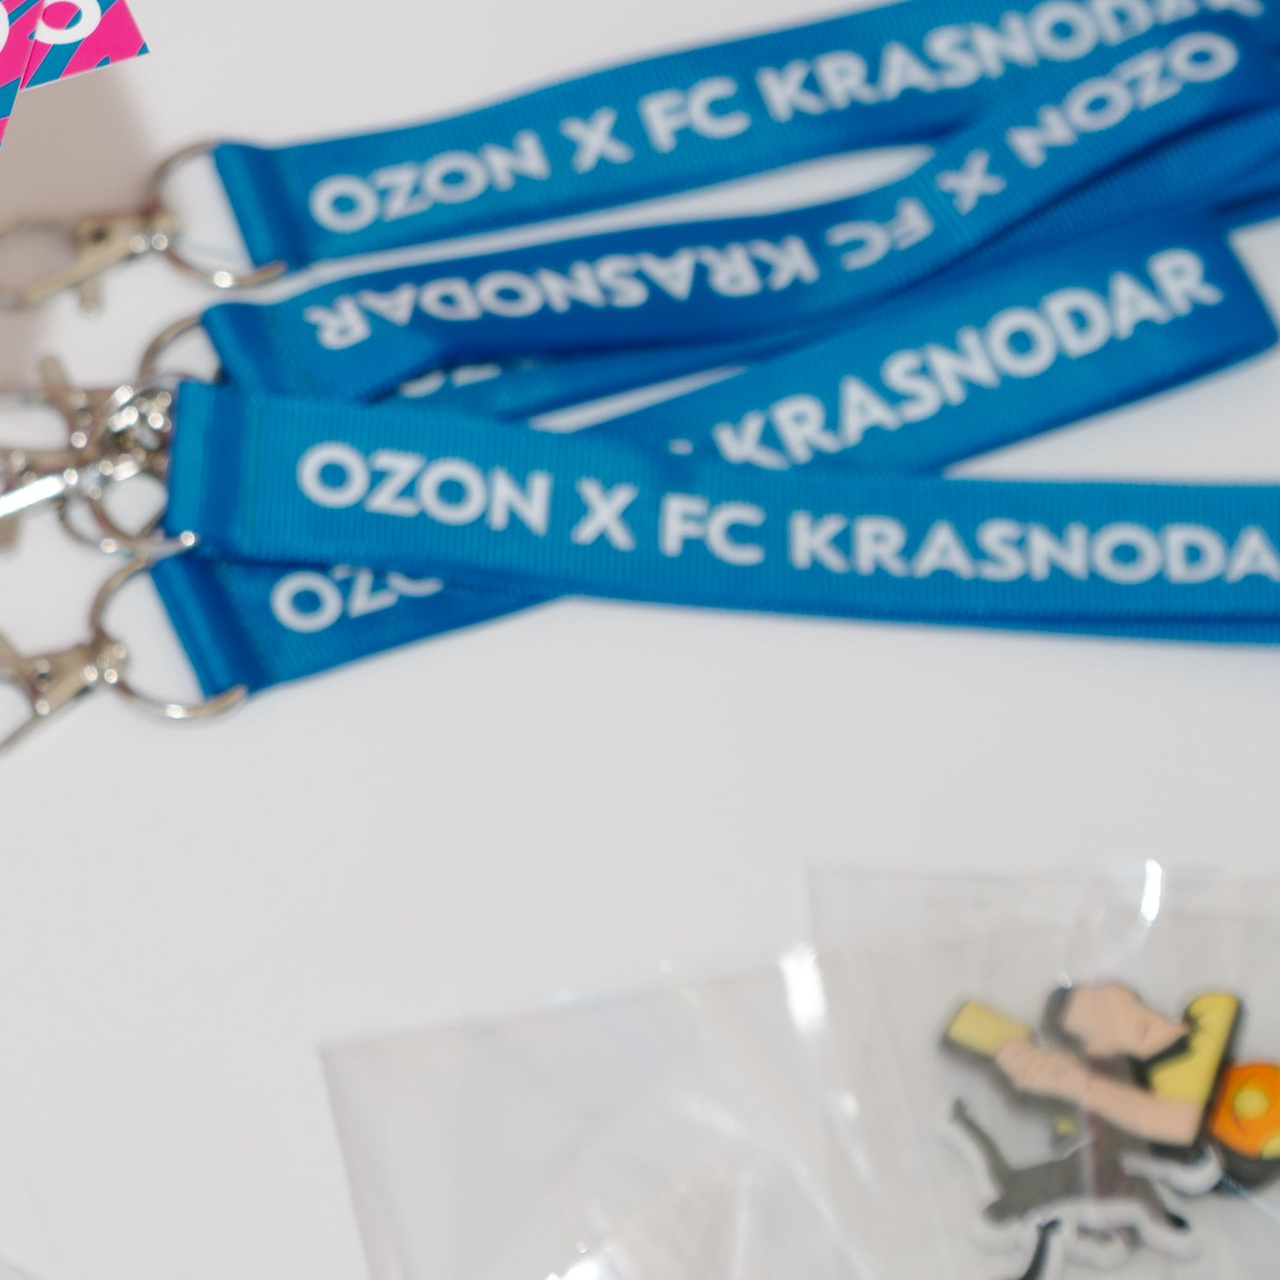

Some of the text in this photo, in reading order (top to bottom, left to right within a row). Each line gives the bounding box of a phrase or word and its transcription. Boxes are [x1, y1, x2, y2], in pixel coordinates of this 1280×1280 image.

[303, 31, 1239, 351] OZON X FC KRASNODAR
[309, 133, 548, 233] OZON
[562, 107, 632, 174] X
[639, 76, 751, 153] FC
[712, 249, 1223, 471] KRASNODAR
[296, 440, 552, 537] OZON
[572, 477, 638, 553] X
[659, 495, 766, 563] FC
